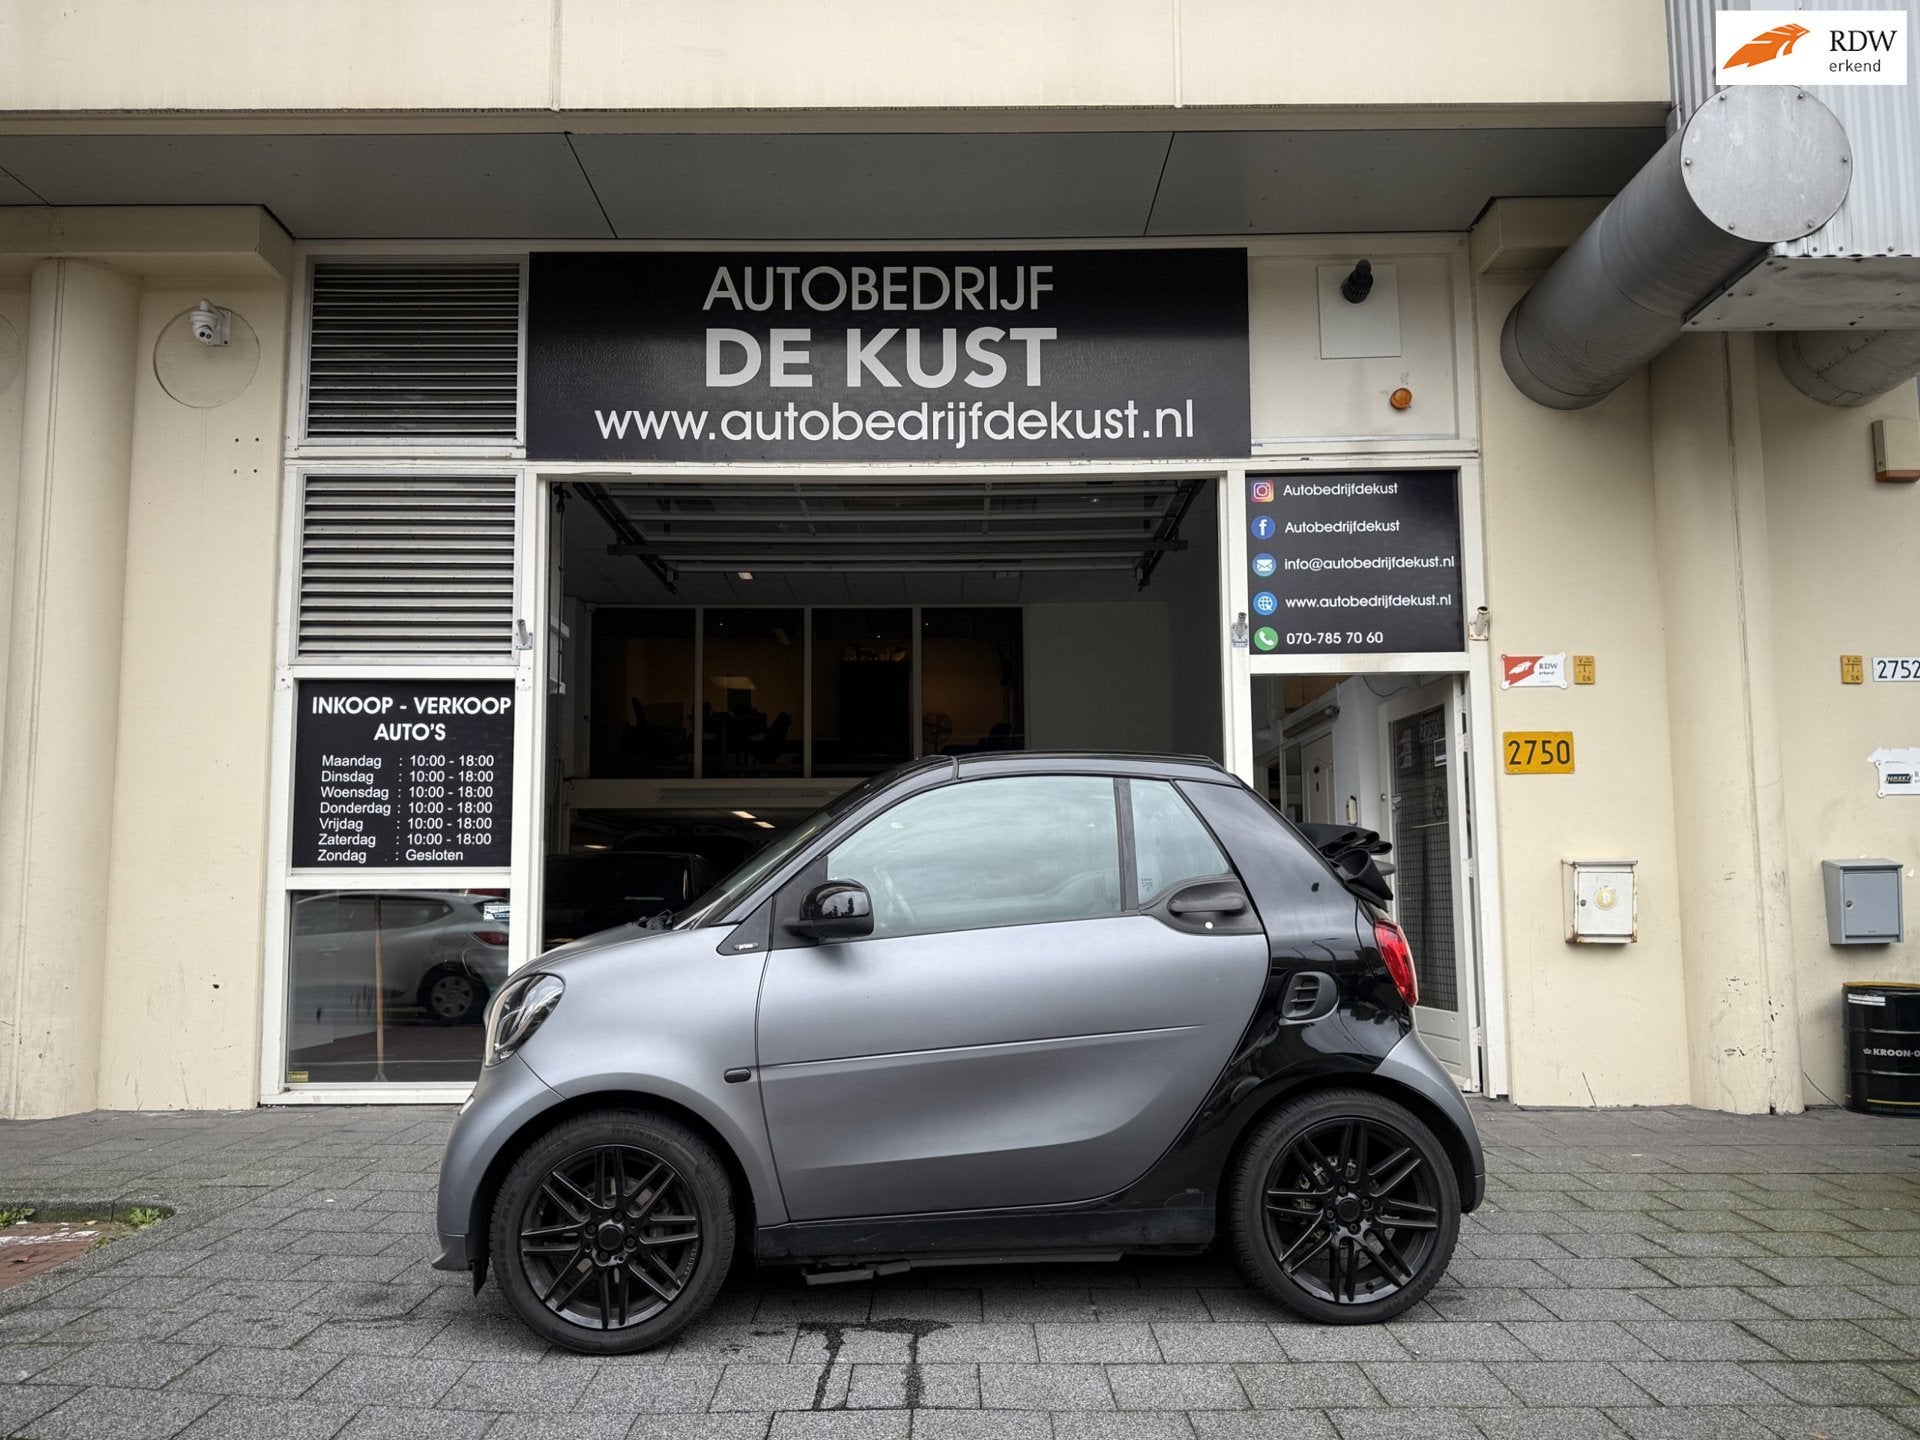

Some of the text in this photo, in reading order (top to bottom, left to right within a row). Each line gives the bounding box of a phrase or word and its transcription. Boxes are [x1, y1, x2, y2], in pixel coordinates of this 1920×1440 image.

[702, 265, 1054, 312] AUTOBEDRIJF
[705, 326, 1058, 389] DE KUST
[594, 399, 1194, 449] www.autobedrijfdekust.nl
[1283, 482, 1399, 498] Autobedrijfdekust
[1284, 519, 1400, 535] Autobedrijfdekust
[1284, 555, 1455, 572] info@autobedrijfdekust.nl
[1285, 594, 1452, 609] www.autobedrijfdekust.nl
[1286, 631, 1384, 645] 070-785 70 60
[1538, 662, 1559, 670] RDW
[1877, 659, 1920, 679] 2752
[312, 696, 394, 715] INKOOP
[413, 696, 512, 715] VERKOOP
[1508, 739, 1571, 766] 2750
[321, 754, 382, 769] Maandag
[409, 754, 446, 767] 10:00
[458, 754, 495, 767] 18:00
[321, 770, 374, 785] Dinsdag
[409, 770, 445, 782] 10:00
[458, 770, 494, 783] 18:00
[320, 785, 389, 800] Woensdag
[408, 785, 445, 798] 10:00
[457, 785, 494, 798] 18:00
[319, 801, 392, 816] Donderdag
[408, 801, 444, 814] 10:00
[457, 801, 493, 814] 18:00
[318, 817, 364, 832] Vrijdag
[407, 817, 444, 830] 10:00
[456, 817, 493, 830] 18:00
[318, 833, 376, 848] Zaterdag
[406, 832, 443, 845] 10:00
[455, 832, 492, 845] 18:00
[317, 848, 367, 863] Zondag
[405, 848, 464, 862] Gesloten
